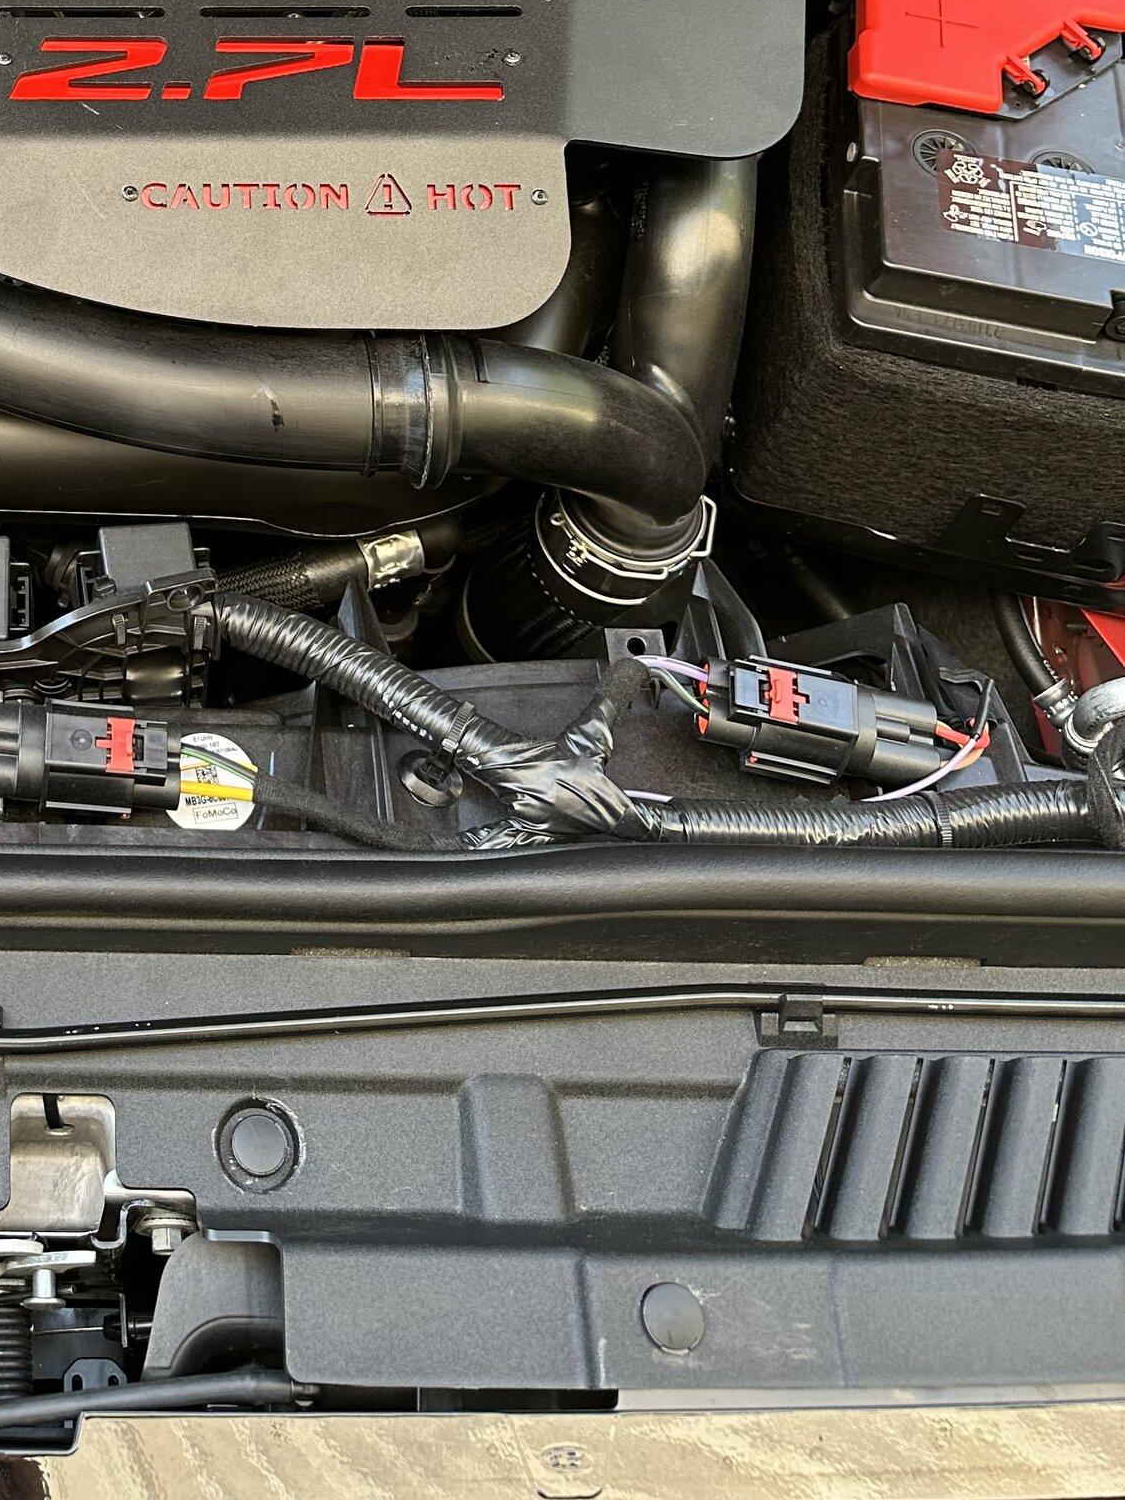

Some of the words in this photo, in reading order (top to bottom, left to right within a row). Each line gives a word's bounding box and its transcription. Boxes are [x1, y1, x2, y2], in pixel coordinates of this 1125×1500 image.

[8, 35, 504, 102] 2.7L
[141, 181, 349, 212] CAUTION
[427, 183, 522, 212] HOT
[195, 806, 237, 819] FoMoCo
